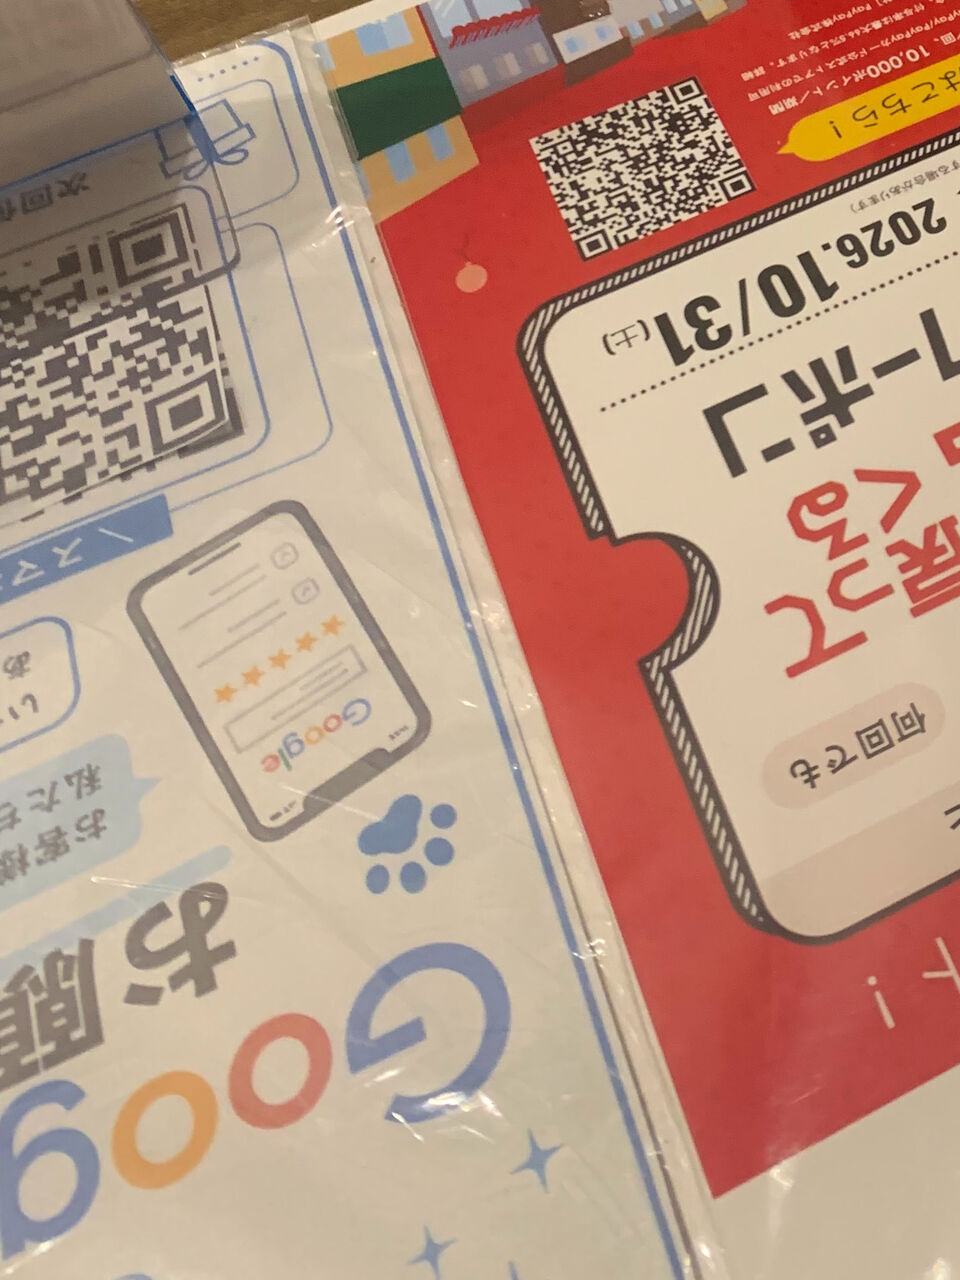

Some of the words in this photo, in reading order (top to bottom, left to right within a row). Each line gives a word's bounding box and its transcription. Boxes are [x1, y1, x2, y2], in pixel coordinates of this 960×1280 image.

[0, 538, 82, 586] スマ
[261, 697, 371, 773] Google
[788, 702, 929, 790] 何回でも
